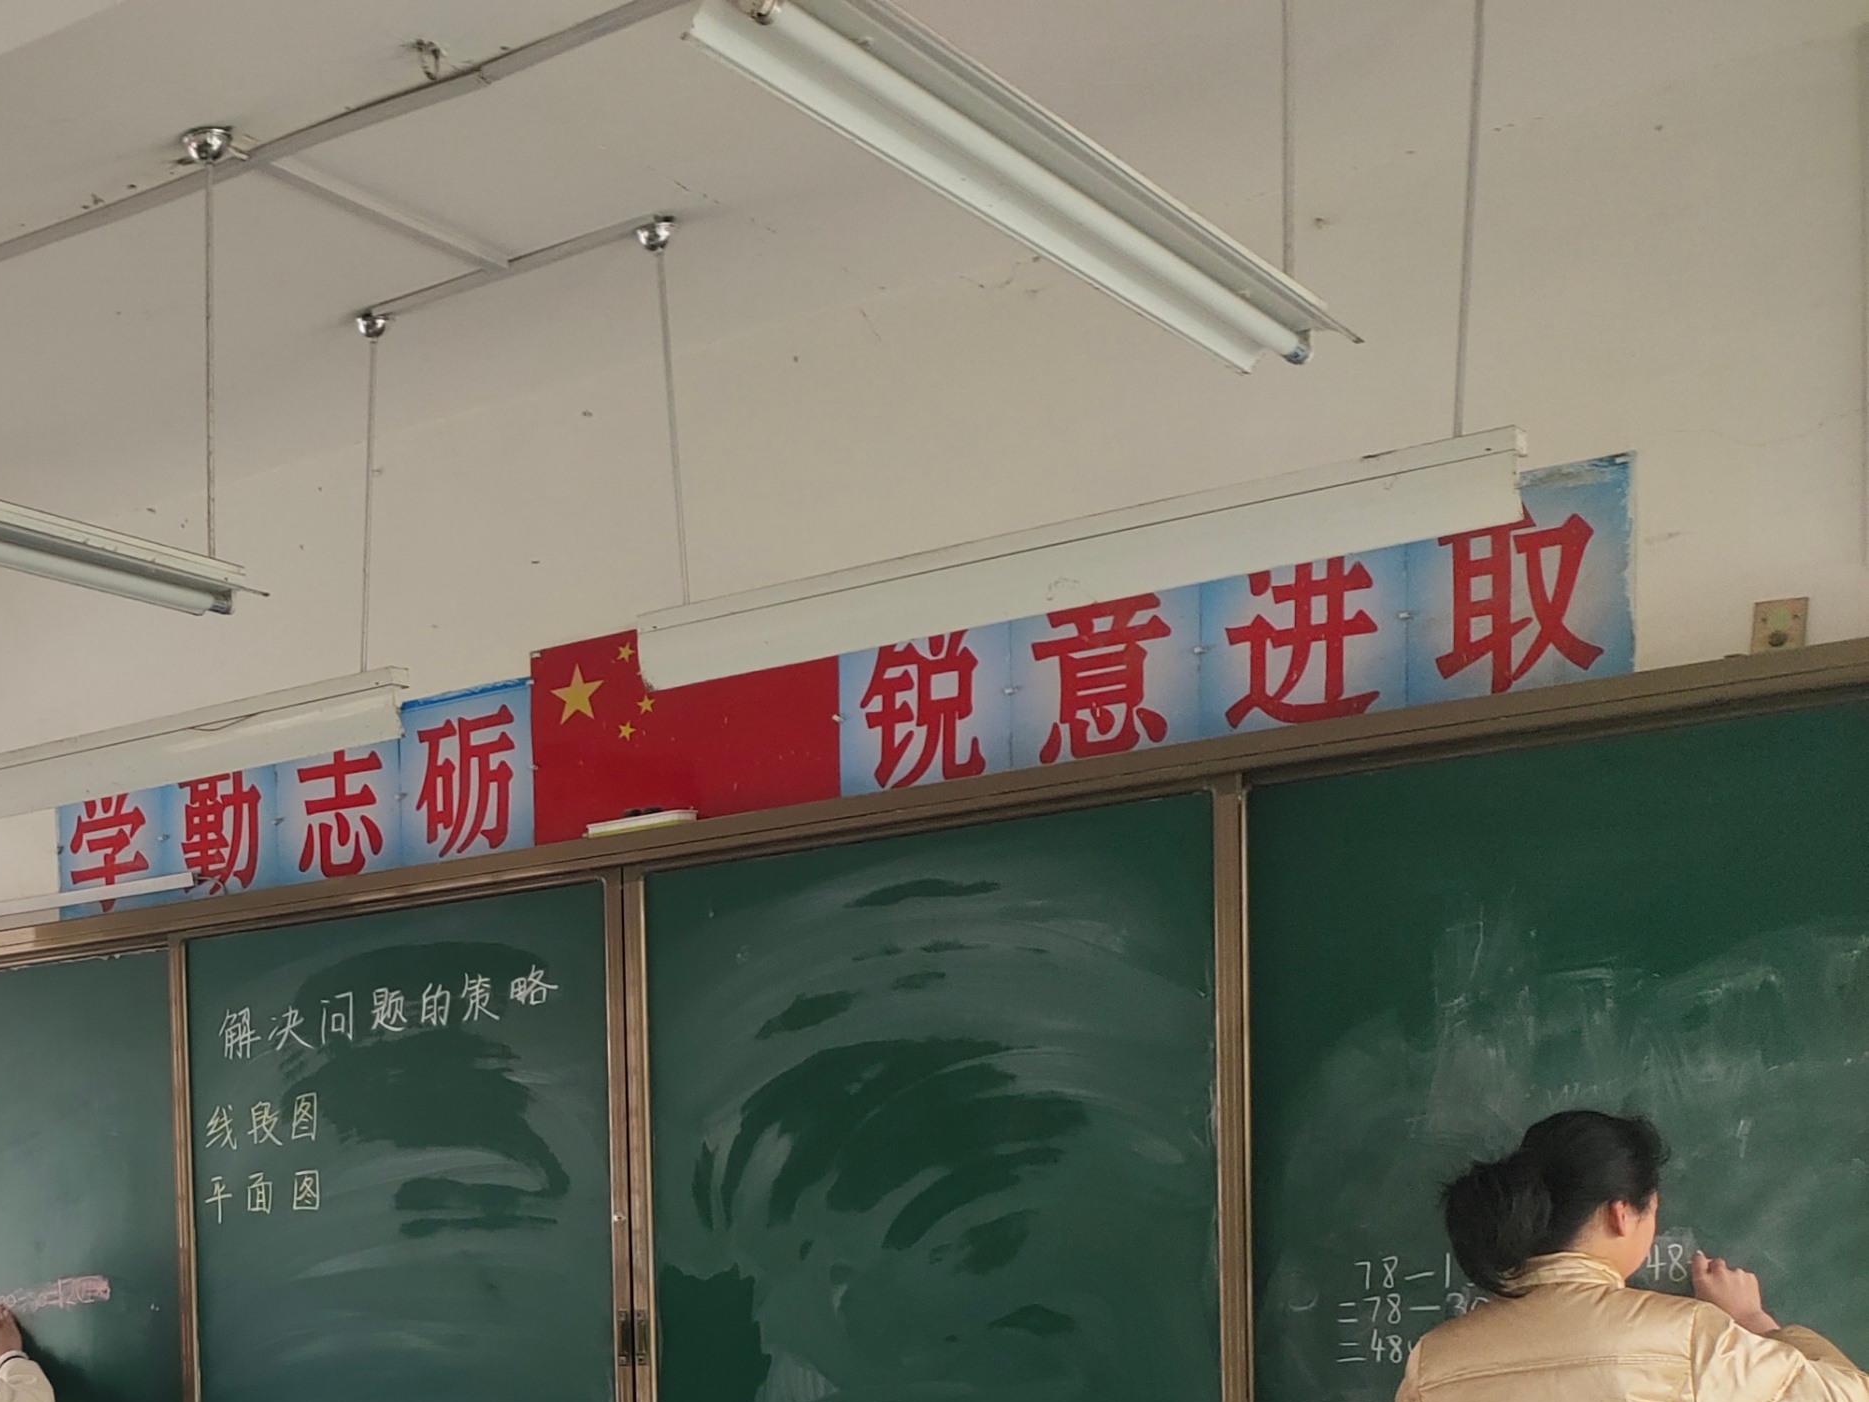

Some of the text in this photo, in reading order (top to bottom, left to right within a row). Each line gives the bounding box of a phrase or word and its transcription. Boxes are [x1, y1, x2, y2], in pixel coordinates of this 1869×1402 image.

[859, 502, 1606, 790] 锐意进取
[70, 704, 516, 912] 学勤志砺
[218, 964, 560, 1060] 解决问题的策略
[205, 1092, 318, 1150] 线段图
[205, 1169, 320, 1224] 平面图
[1337, 1328, 1412, 1363] =48
